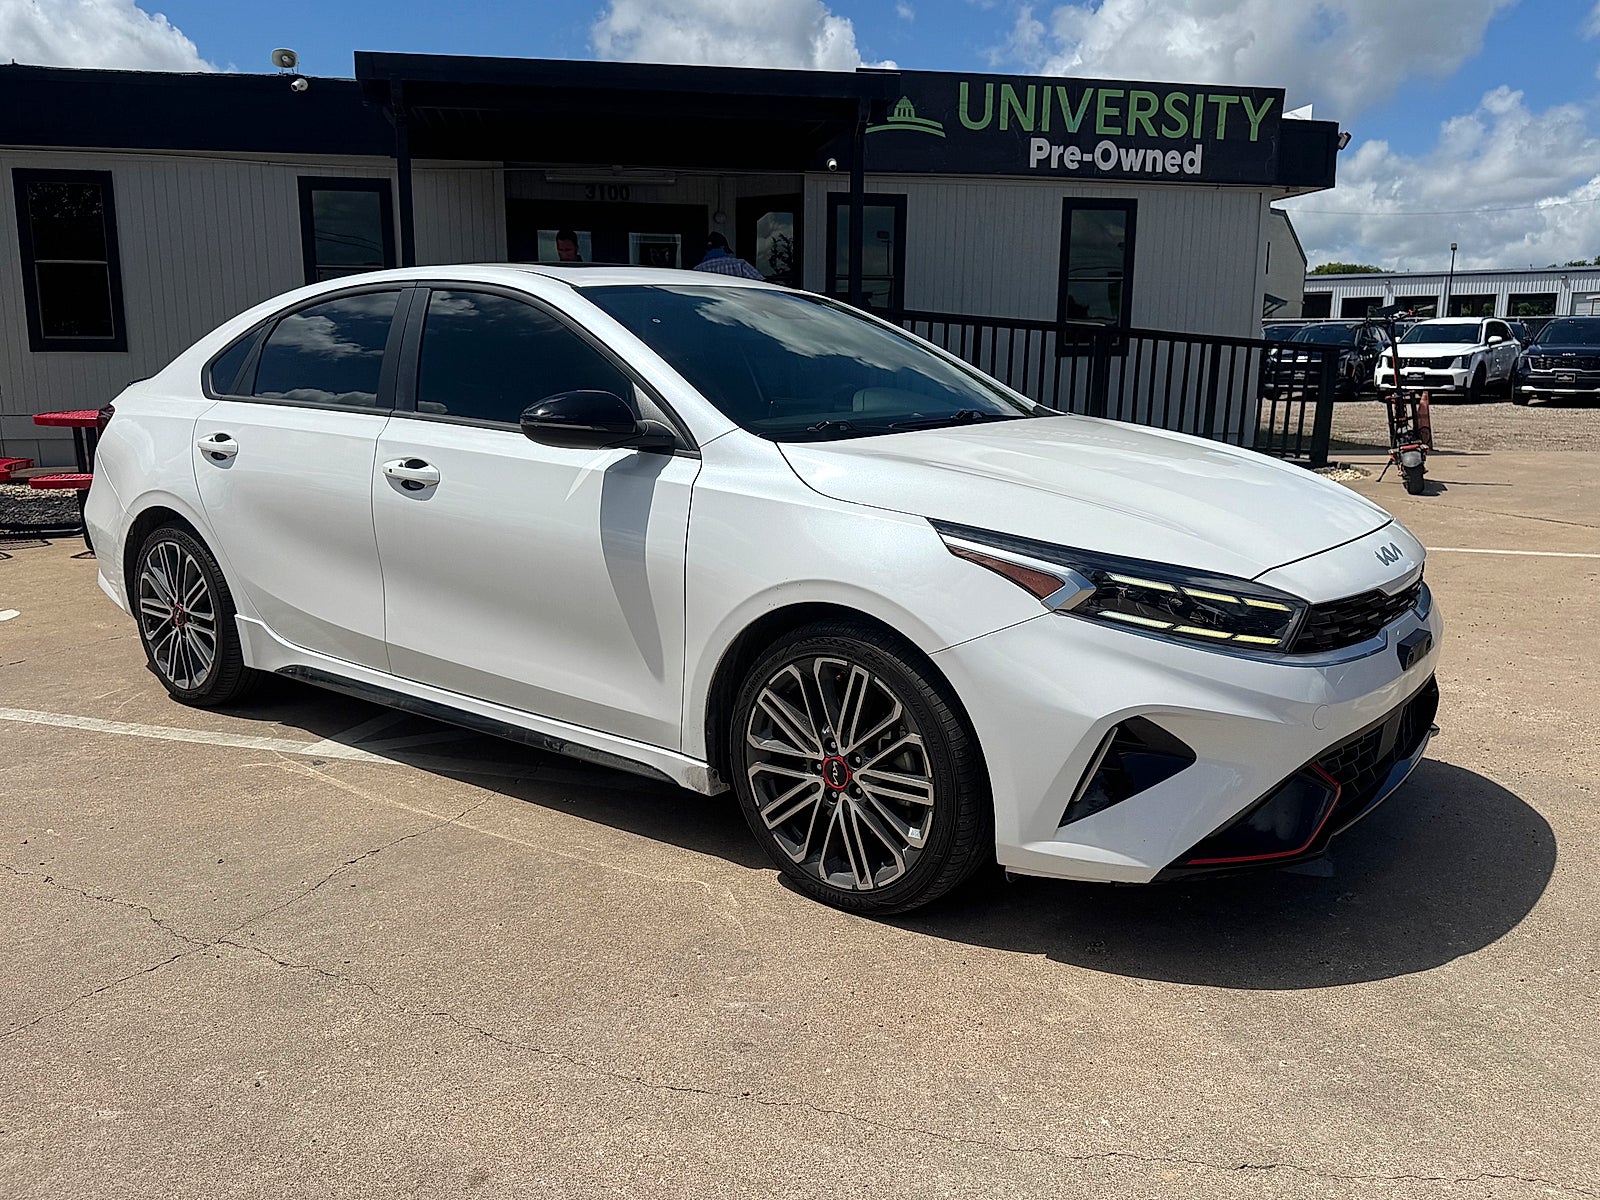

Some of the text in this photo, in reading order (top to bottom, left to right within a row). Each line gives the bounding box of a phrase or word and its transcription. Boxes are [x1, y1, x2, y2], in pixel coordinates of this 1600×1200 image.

[958, 81, 1275, 142] UNIVERSITY
[1029, 137, 1203, 174] Pre-Owned
[584, 184, 630, 200] 3100
